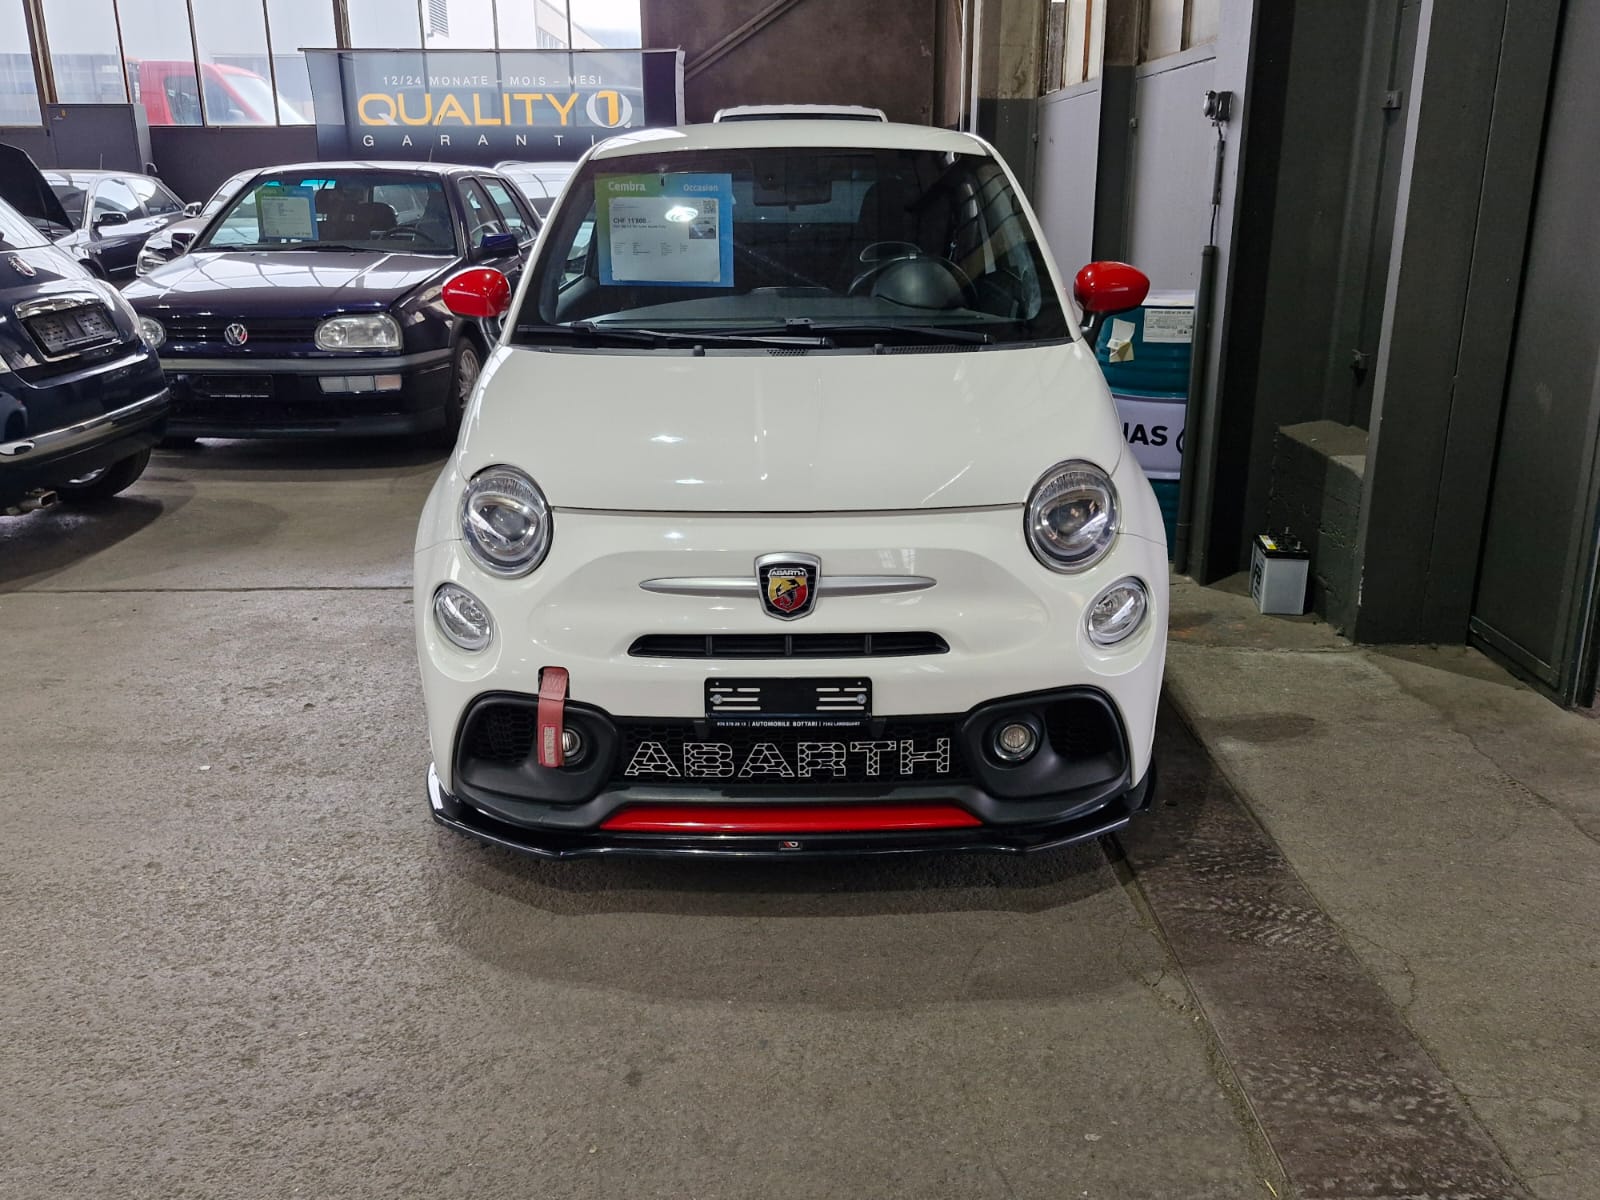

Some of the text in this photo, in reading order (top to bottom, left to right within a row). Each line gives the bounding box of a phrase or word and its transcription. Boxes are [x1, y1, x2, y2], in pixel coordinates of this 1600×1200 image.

[383, 76, 422, 86] 12/24
[429, 76, 489, 86] MONATE
[510, 76, 546, 86] MOIS
[568, 75, 602, 85] MESI
[357, 92, 579, 127] QUALITY
[608, 181, 647, 192] Cembra
[683, 183, 719, 192] Occasion
[624, 737, 950, 778] ABARTH
